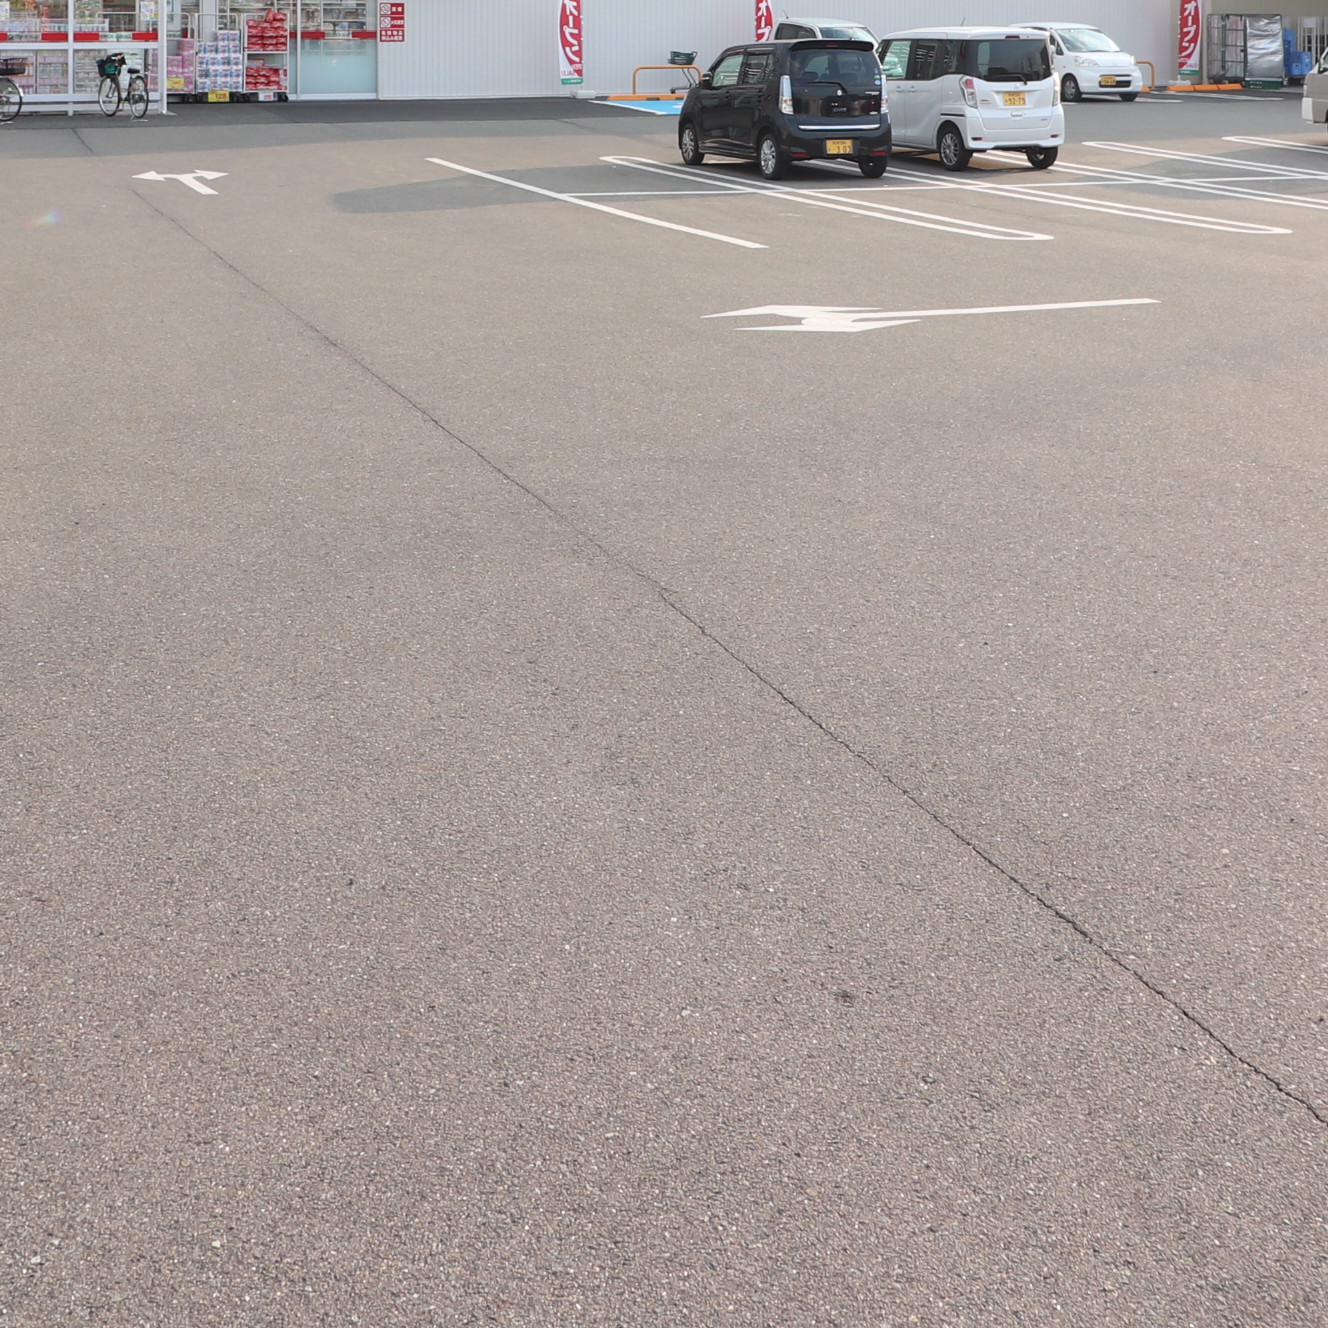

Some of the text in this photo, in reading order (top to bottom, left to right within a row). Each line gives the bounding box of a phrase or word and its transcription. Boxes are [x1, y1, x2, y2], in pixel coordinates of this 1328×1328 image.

[757, 0, 771, 42] オープ
[1181, 1, 1197, 56] オープン
